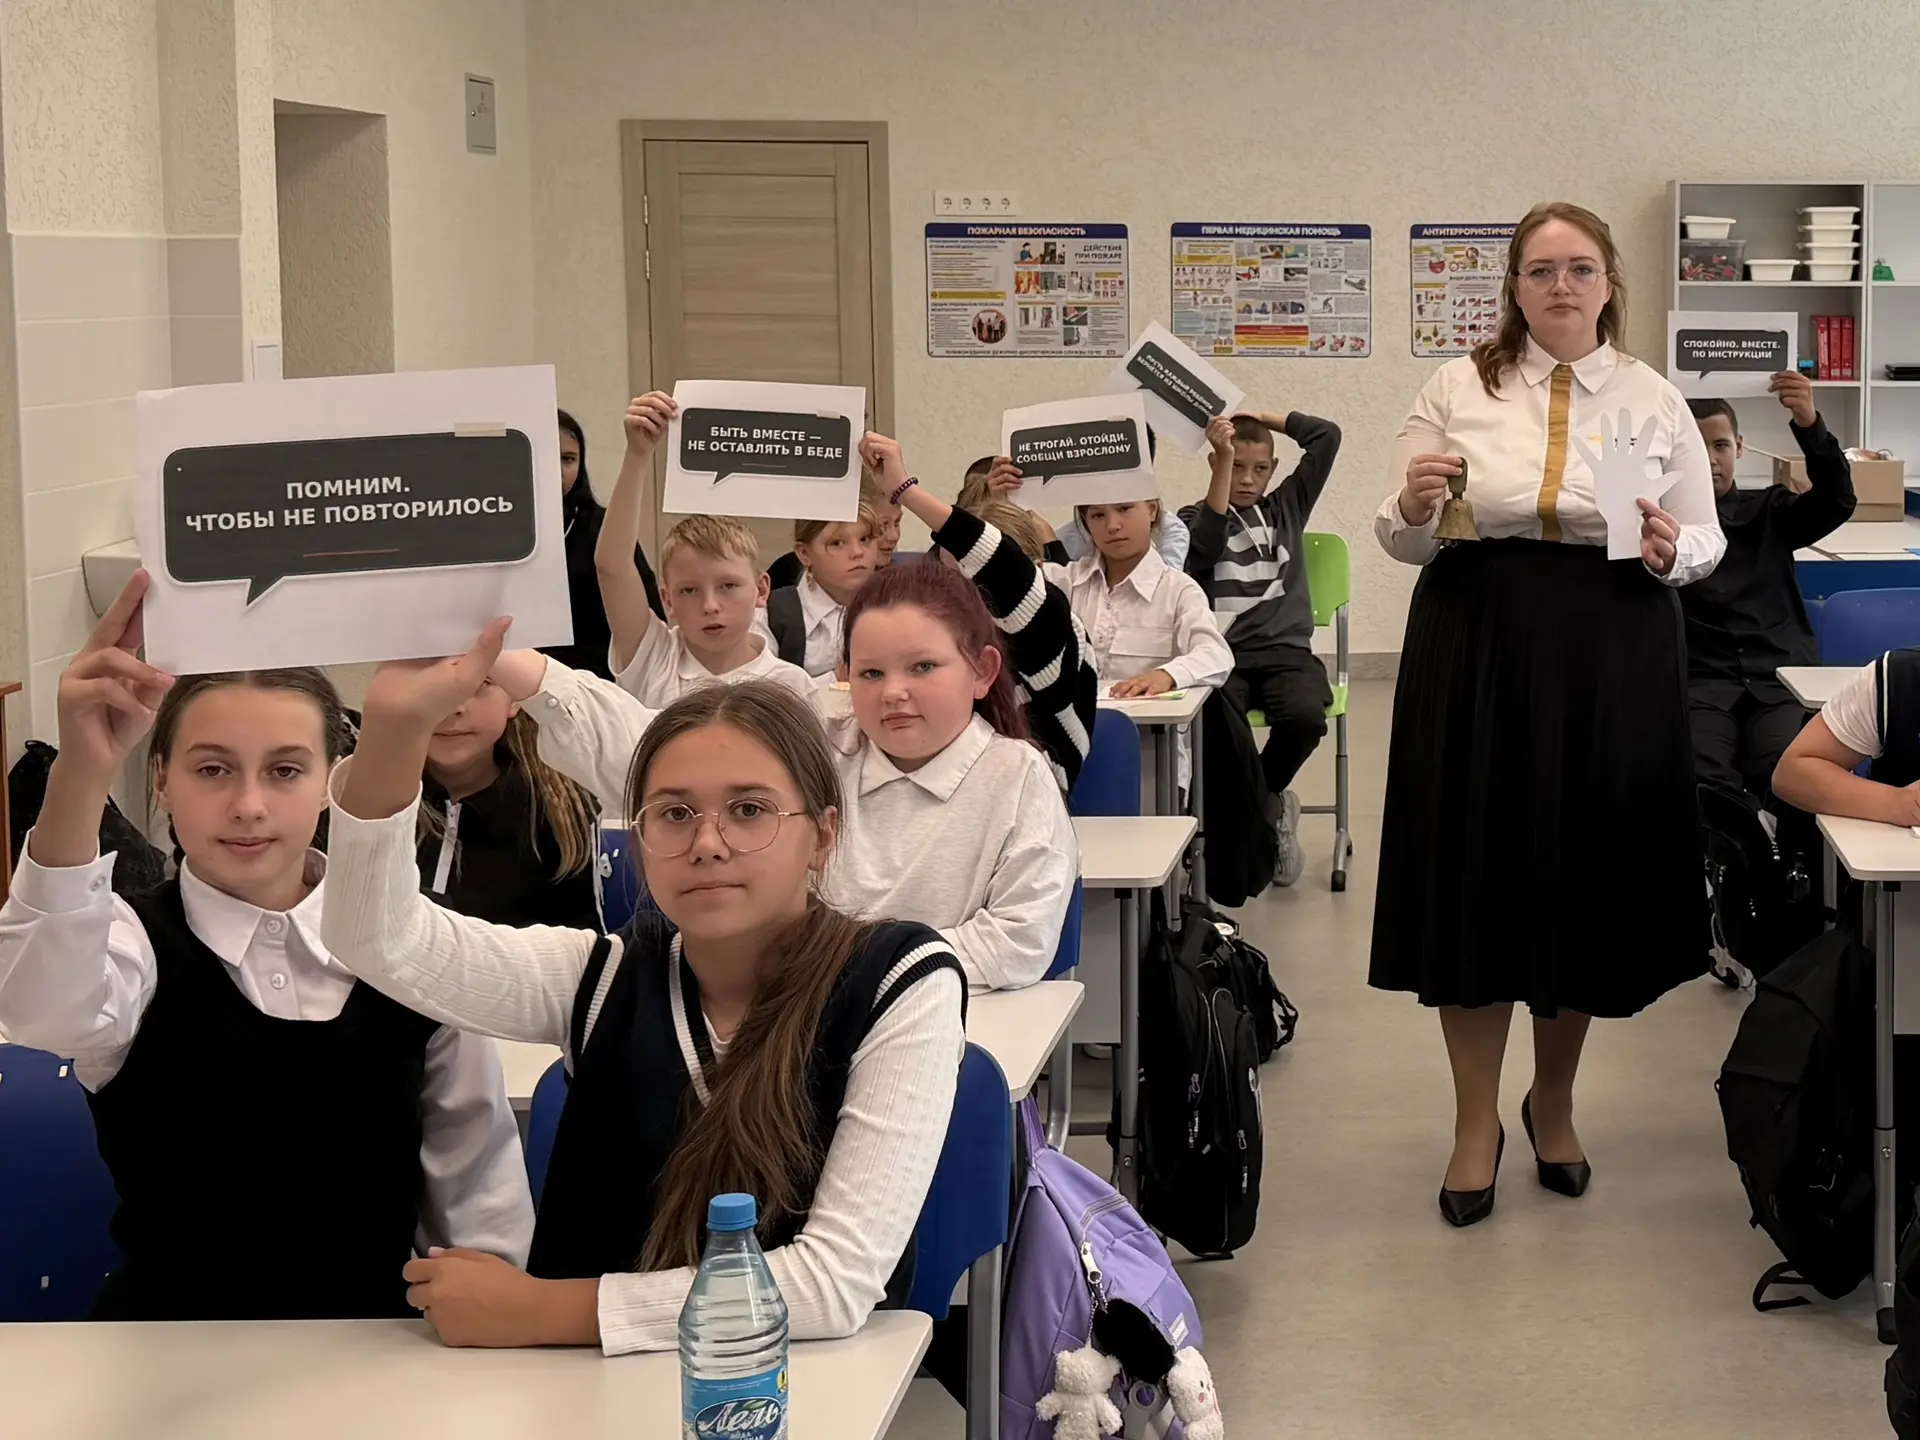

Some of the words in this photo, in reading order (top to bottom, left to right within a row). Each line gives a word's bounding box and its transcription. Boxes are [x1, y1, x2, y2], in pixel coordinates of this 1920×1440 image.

[967, 227, 1017, 236] ПОЖАРНАЯ
[1018, 227, 1086, 236] БЕЗОПАСНОСТЬ
[1201, 226, 1234, 235] ПЕРВАЯ
[1235, 226, 1300, 236] МЕДИЦИНСКАЯ
[1301, 227, 1341, 236] ПОМОЩЬ
[1741, 340, 1781, 349] ВМЕСТЕ.
[1692, 350, 1706, 358] ПО
[1708, 351, 1772, 359] ИНСТРУКЦИИ
[711, 426, 748, 438] БЫТЬ
[753, 429, 806, 441] ВМЕСТЕ
[1018, 443, 1032, 453] НЕ
[1033, 437, 1077, 451] ТРОГАЙ.
[1080, 432, 1128, 446] ОТОЙДИ.
[688, 440, 706, 451] НЕ
[709, 441, 790, 456] ОСТАВЛЯТЬ
[794, 446, 803, 456] В
[807, 447, 843, 459] БЕДЕ
[1016, 451, 1064, 464] СООБЩИ
[1066, 444, 1131, 459] ВЗРОСЛОМУ
[286, 475, 410, 500] ПОМНИМ.
[186, 509, 275, 532] ЧТОБЫ
[283, 507, 316, 527] НЕ
[323, 496, 514, 524] ПОВТОРИЛОСЬ
[697, 1402, 778, 1434] Лель
